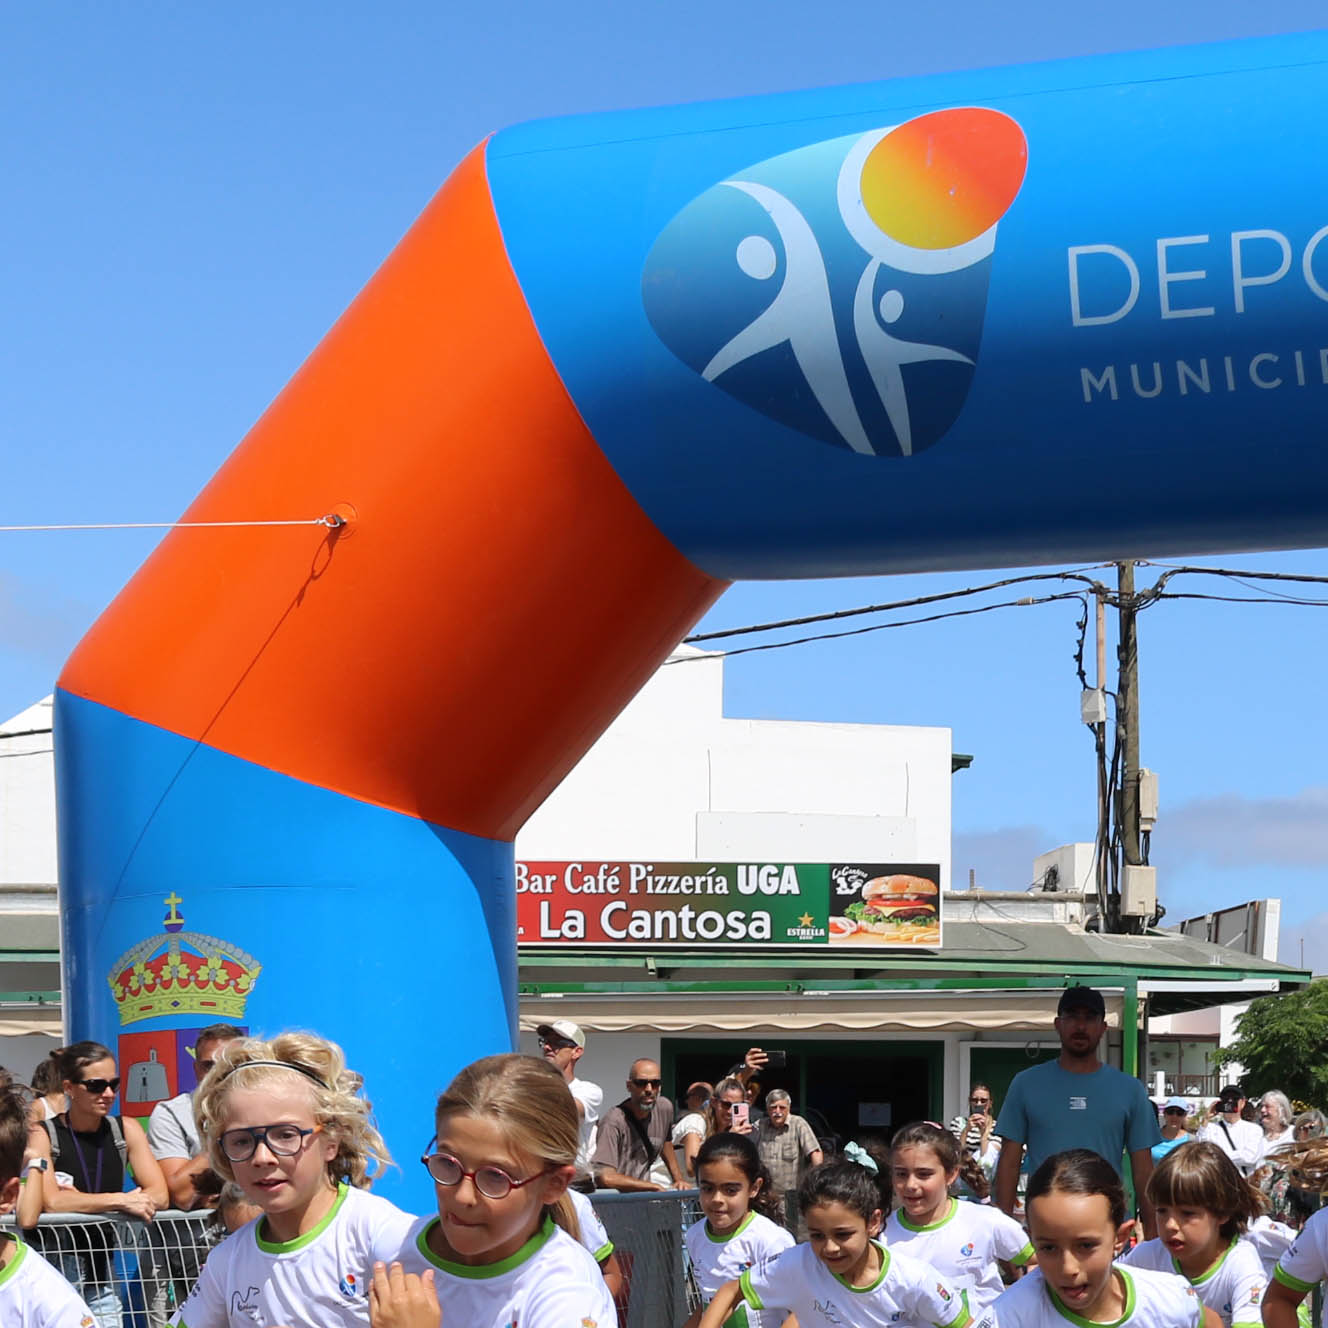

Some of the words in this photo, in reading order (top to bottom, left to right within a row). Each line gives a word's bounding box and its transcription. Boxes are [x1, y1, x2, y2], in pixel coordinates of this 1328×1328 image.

[515, 864, 557, 895] Bar
[564, 863, 621, 895] Café
[629, 864, 730, 896] Pizzería
[737, 865, 801, 895] UGA
[539, 901, 585, 939] La
[600, 900, 772, 941] Cantosa
[787, 928, 826, 936] ESTRELLA
